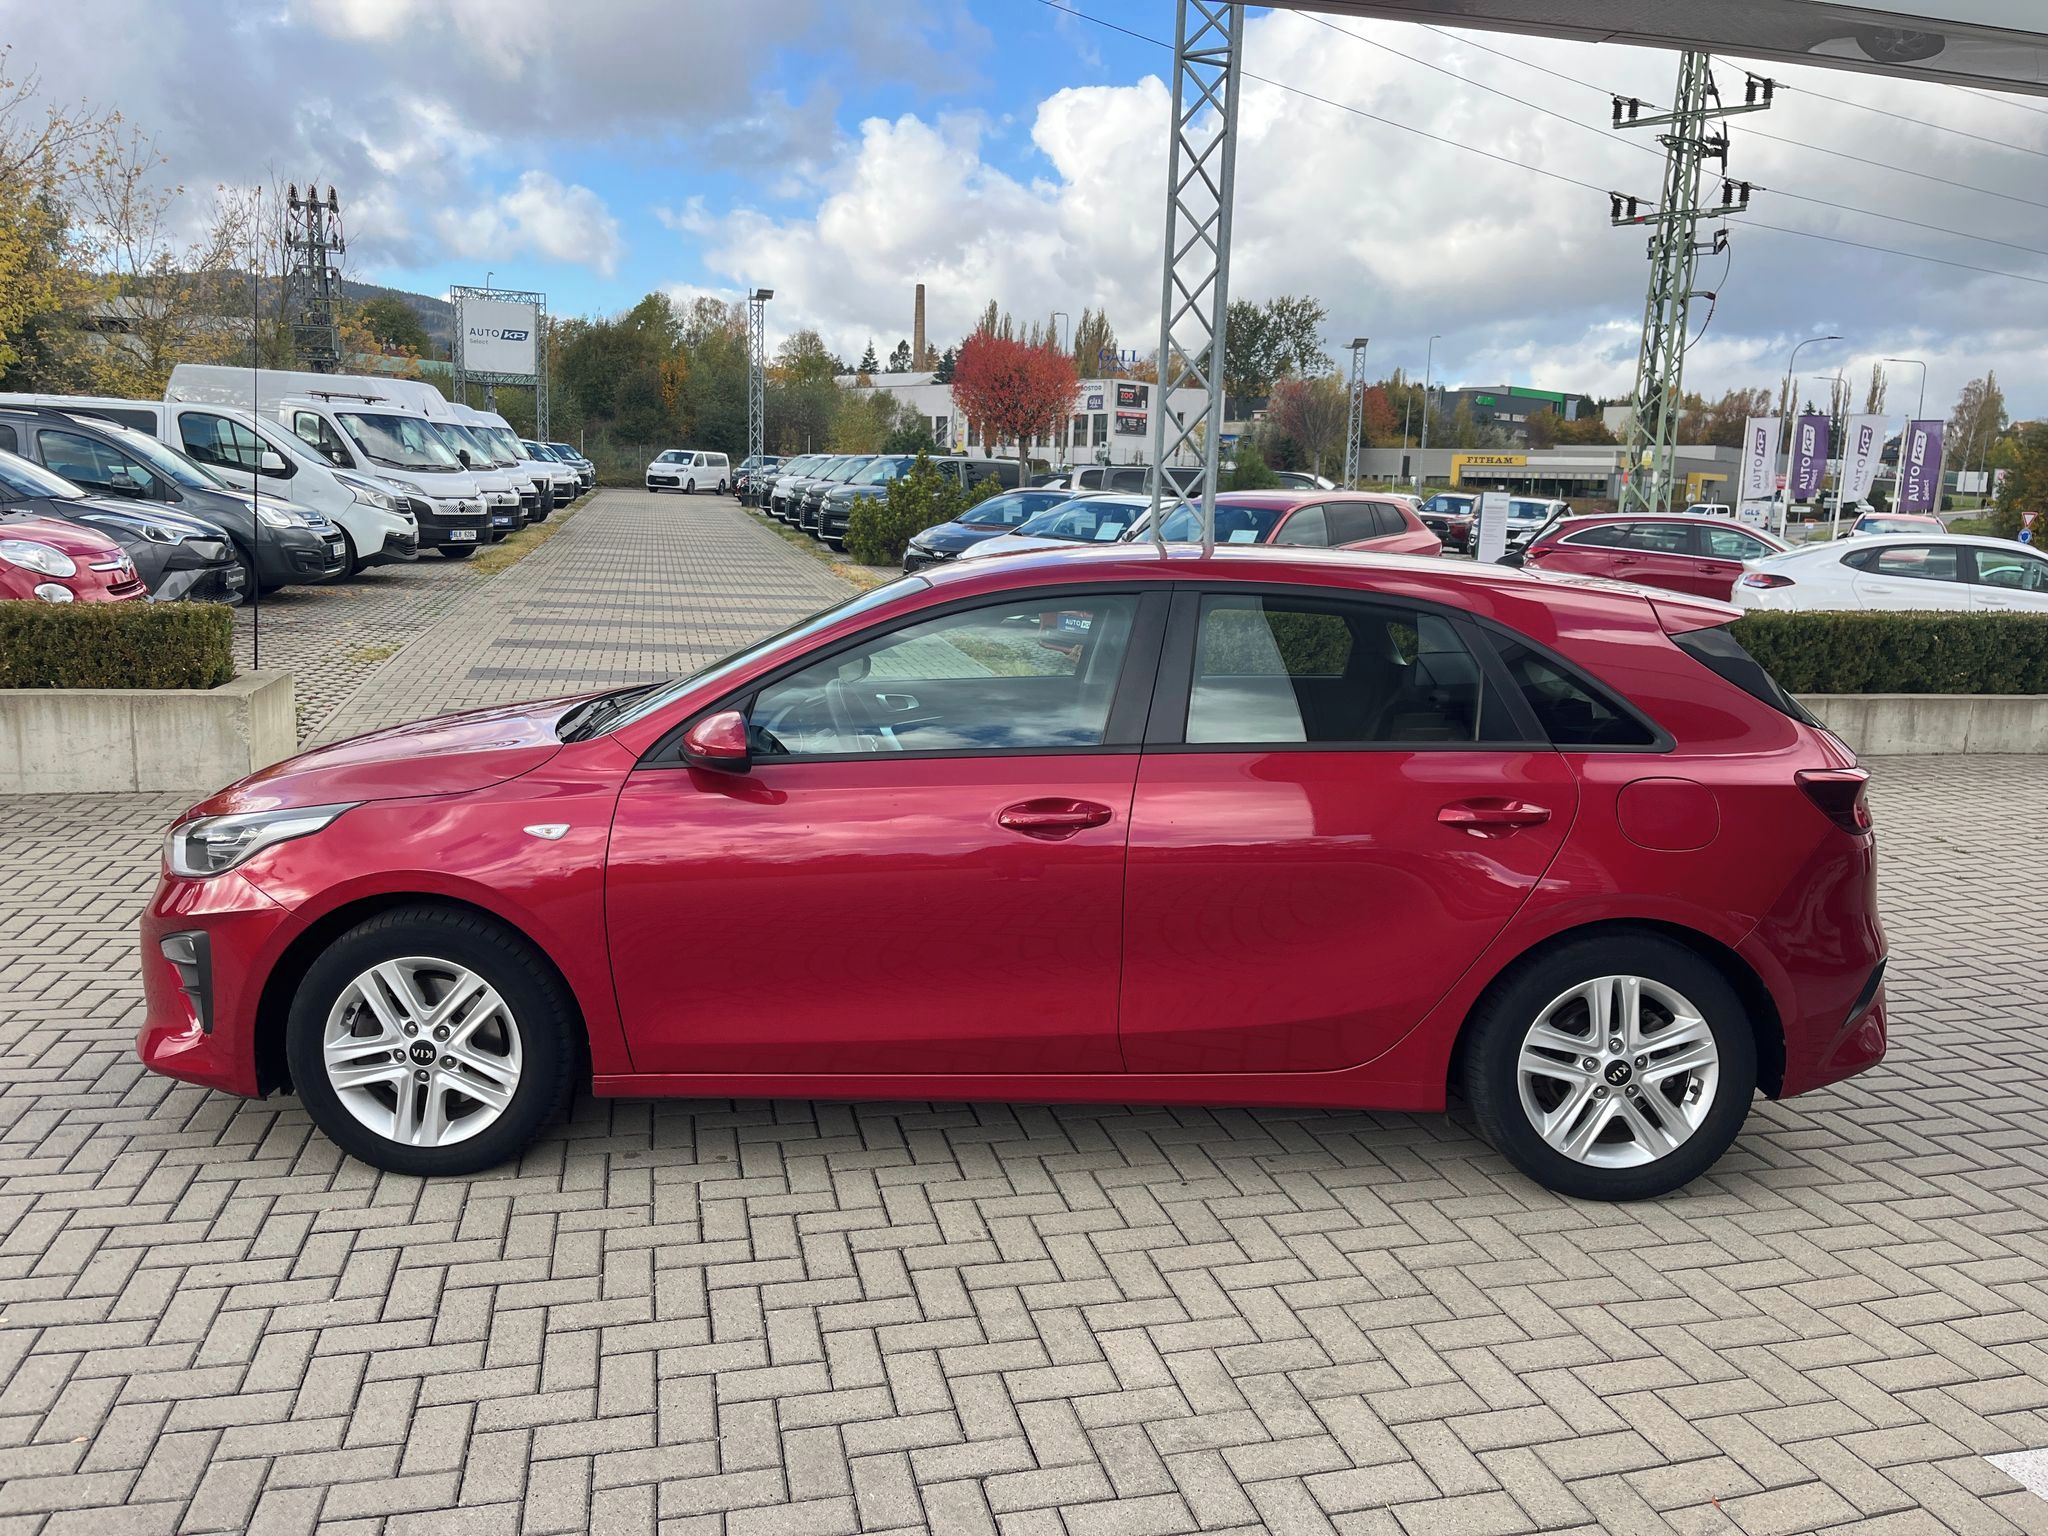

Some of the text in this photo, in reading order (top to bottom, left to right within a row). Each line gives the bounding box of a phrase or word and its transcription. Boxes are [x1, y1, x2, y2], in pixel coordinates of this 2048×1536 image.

[470, 328, 499, 337] AUTO
[1466, 456, 1513, 464] FITHAM
[1753, 459, 1762, 489] AUTO
[1800, 457, 1810, 489] AUTO
[1853, 459, 1865, 491] AUTO
[1908, 465, 1920, 501] AUTO
[1065, 618, 1081, 626] AUTO
[412, 1048, 433, 1059] KIA
[1608, 1064, 1629, 1081] KIA
